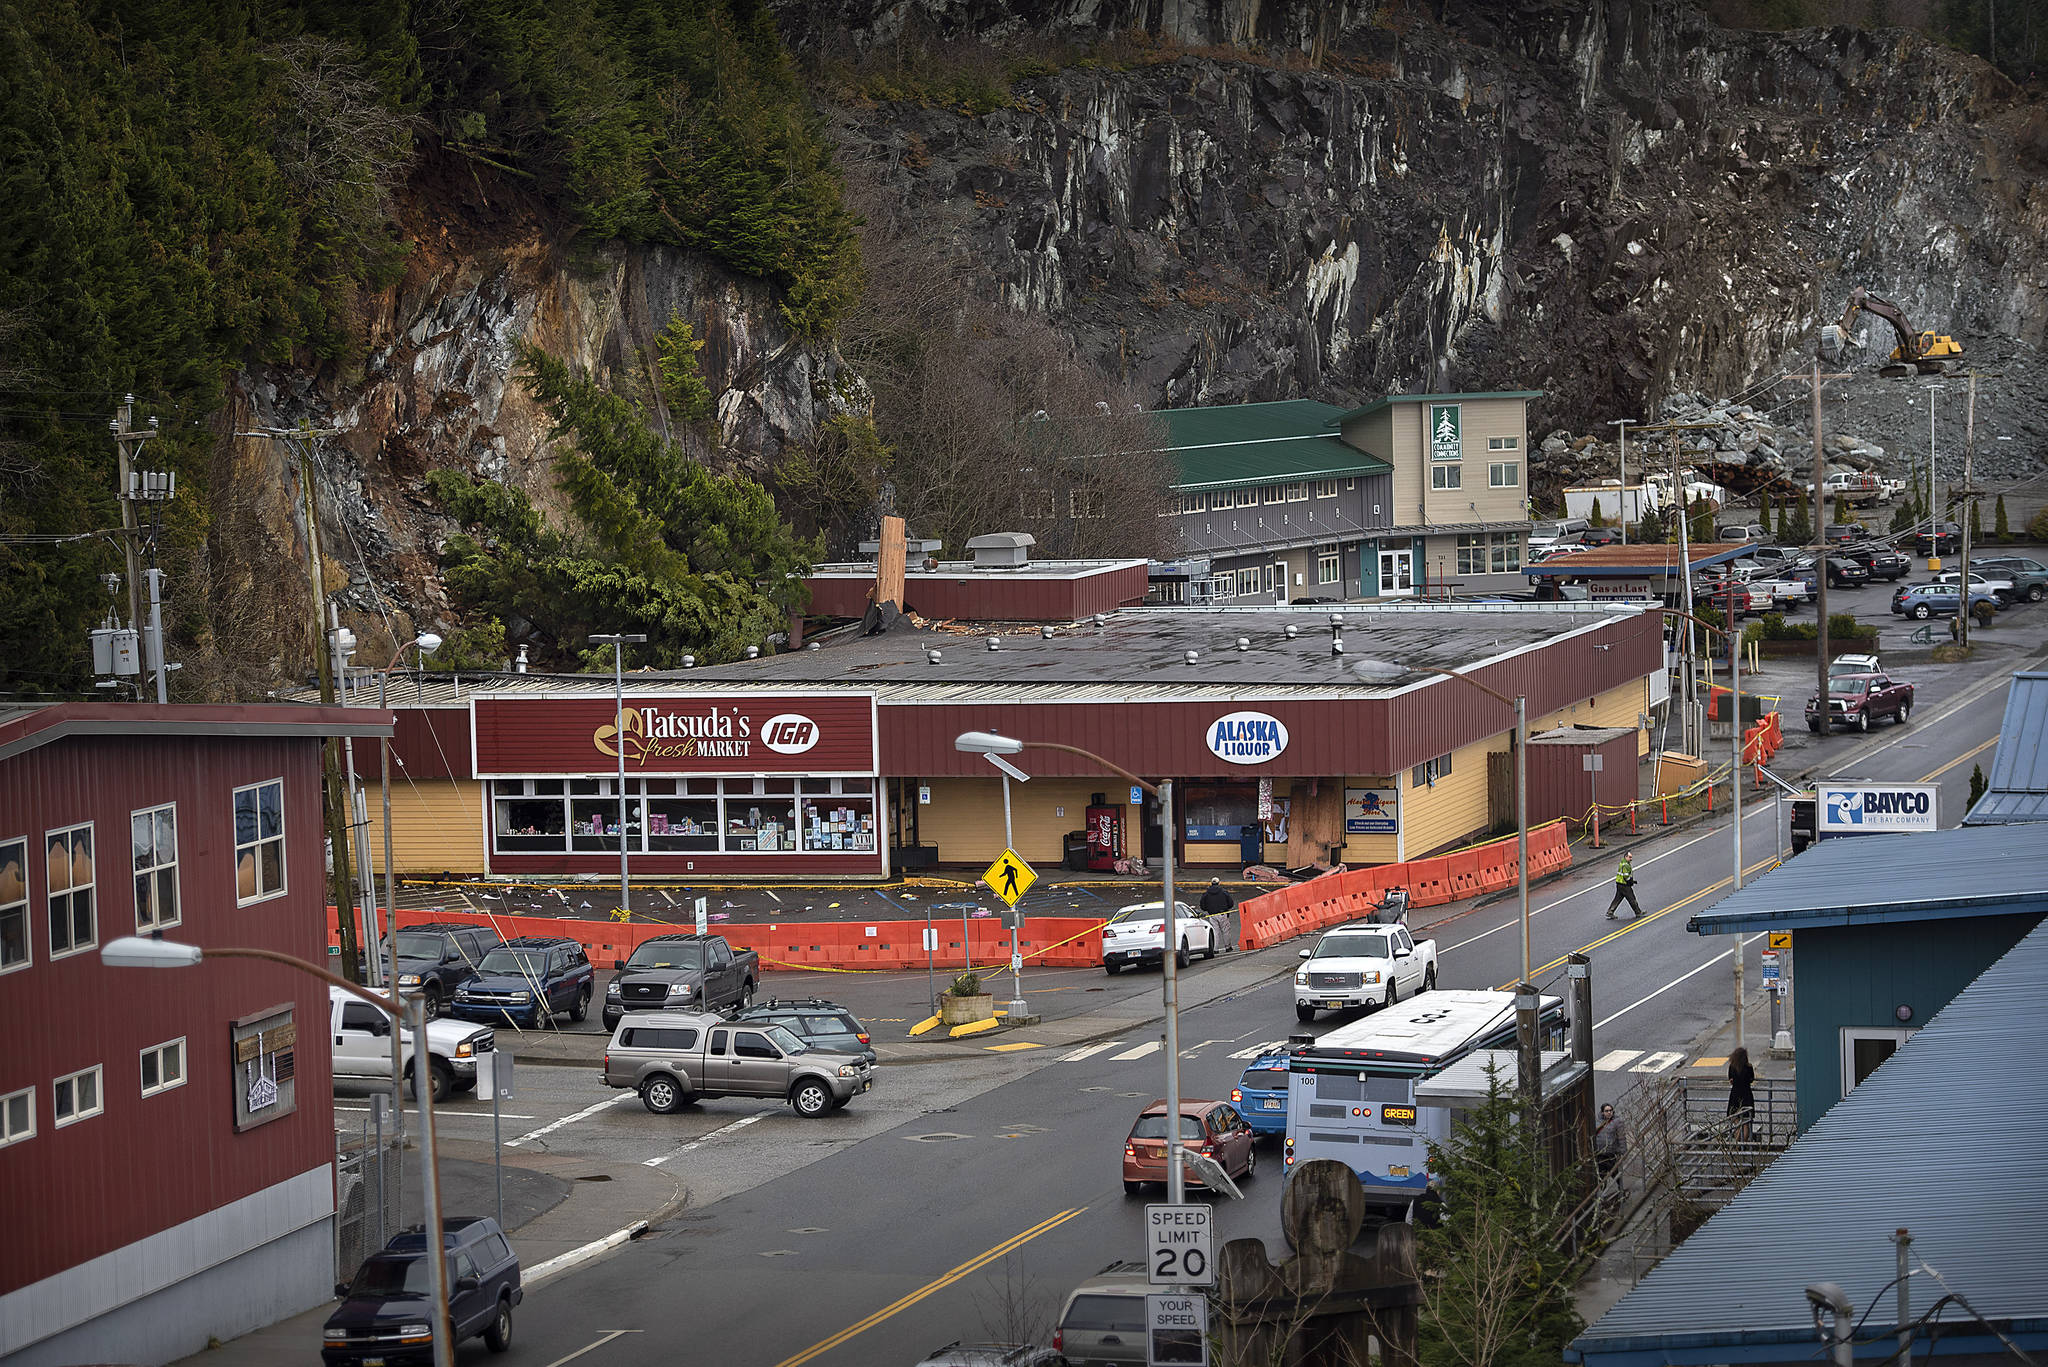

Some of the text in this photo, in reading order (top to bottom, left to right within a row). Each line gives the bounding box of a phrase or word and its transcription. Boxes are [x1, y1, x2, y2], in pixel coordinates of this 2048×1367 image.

[1590, 584, 1648, 593] Gas at Last
[640, 707, 751, 739] Tatsuda's
[767, 722, 813, 745] IGA
[1214, 720, 1282, 751] ALASKA
[640, 737, 751, 767] fresh MARKET
[1224, 742, 1271, 756] LIQUOR
[1864, 792, 1930, 814] BAYCO
[1864, 816, 1930, 824] THE BAY COMPANY
[855, 835, 871, 844] ATM
[1300, 1077, 1315, 1086] 100
[1384, 1108, 1415, 1120] GREEN
[1152, 1212, 1206, 1225] SPEED
[1158, 1231, 1200, 1243] LIMIT
[1155, 1248, 1206, 1277] 20
[1159, 1301, 1193, 1311] YOUR
[1157, 1314, 1196, 1325] SPEED
